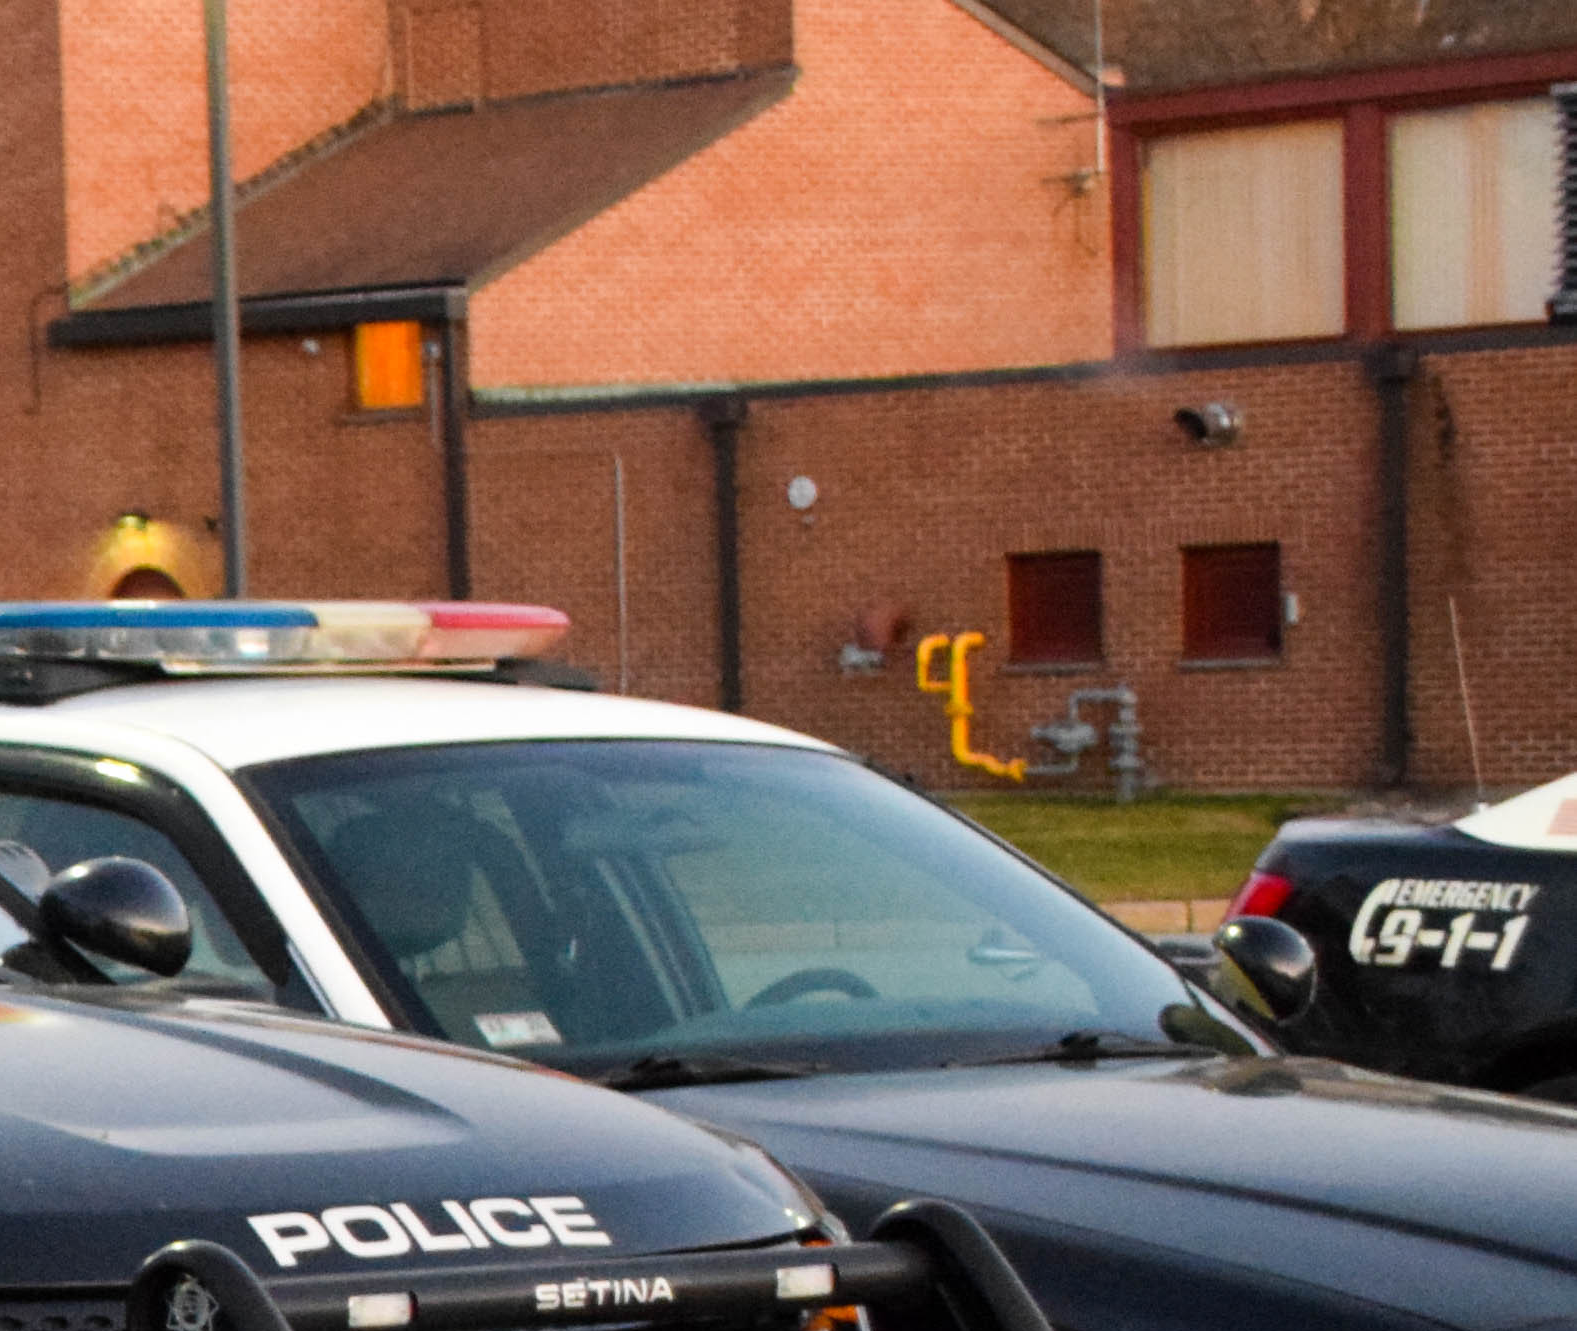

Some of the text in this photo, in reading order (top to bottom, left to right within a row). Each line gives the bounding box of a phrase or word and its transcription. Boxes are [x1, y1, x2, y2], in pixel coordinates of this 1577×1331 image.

[1397, 878, 1542, 911] EMERGENCY
[1374, 909, 1531, 971] 9-1-1
[247, 1195, 614, 1268] POLICE
[534, 1276, 675, 1311] SETINA
